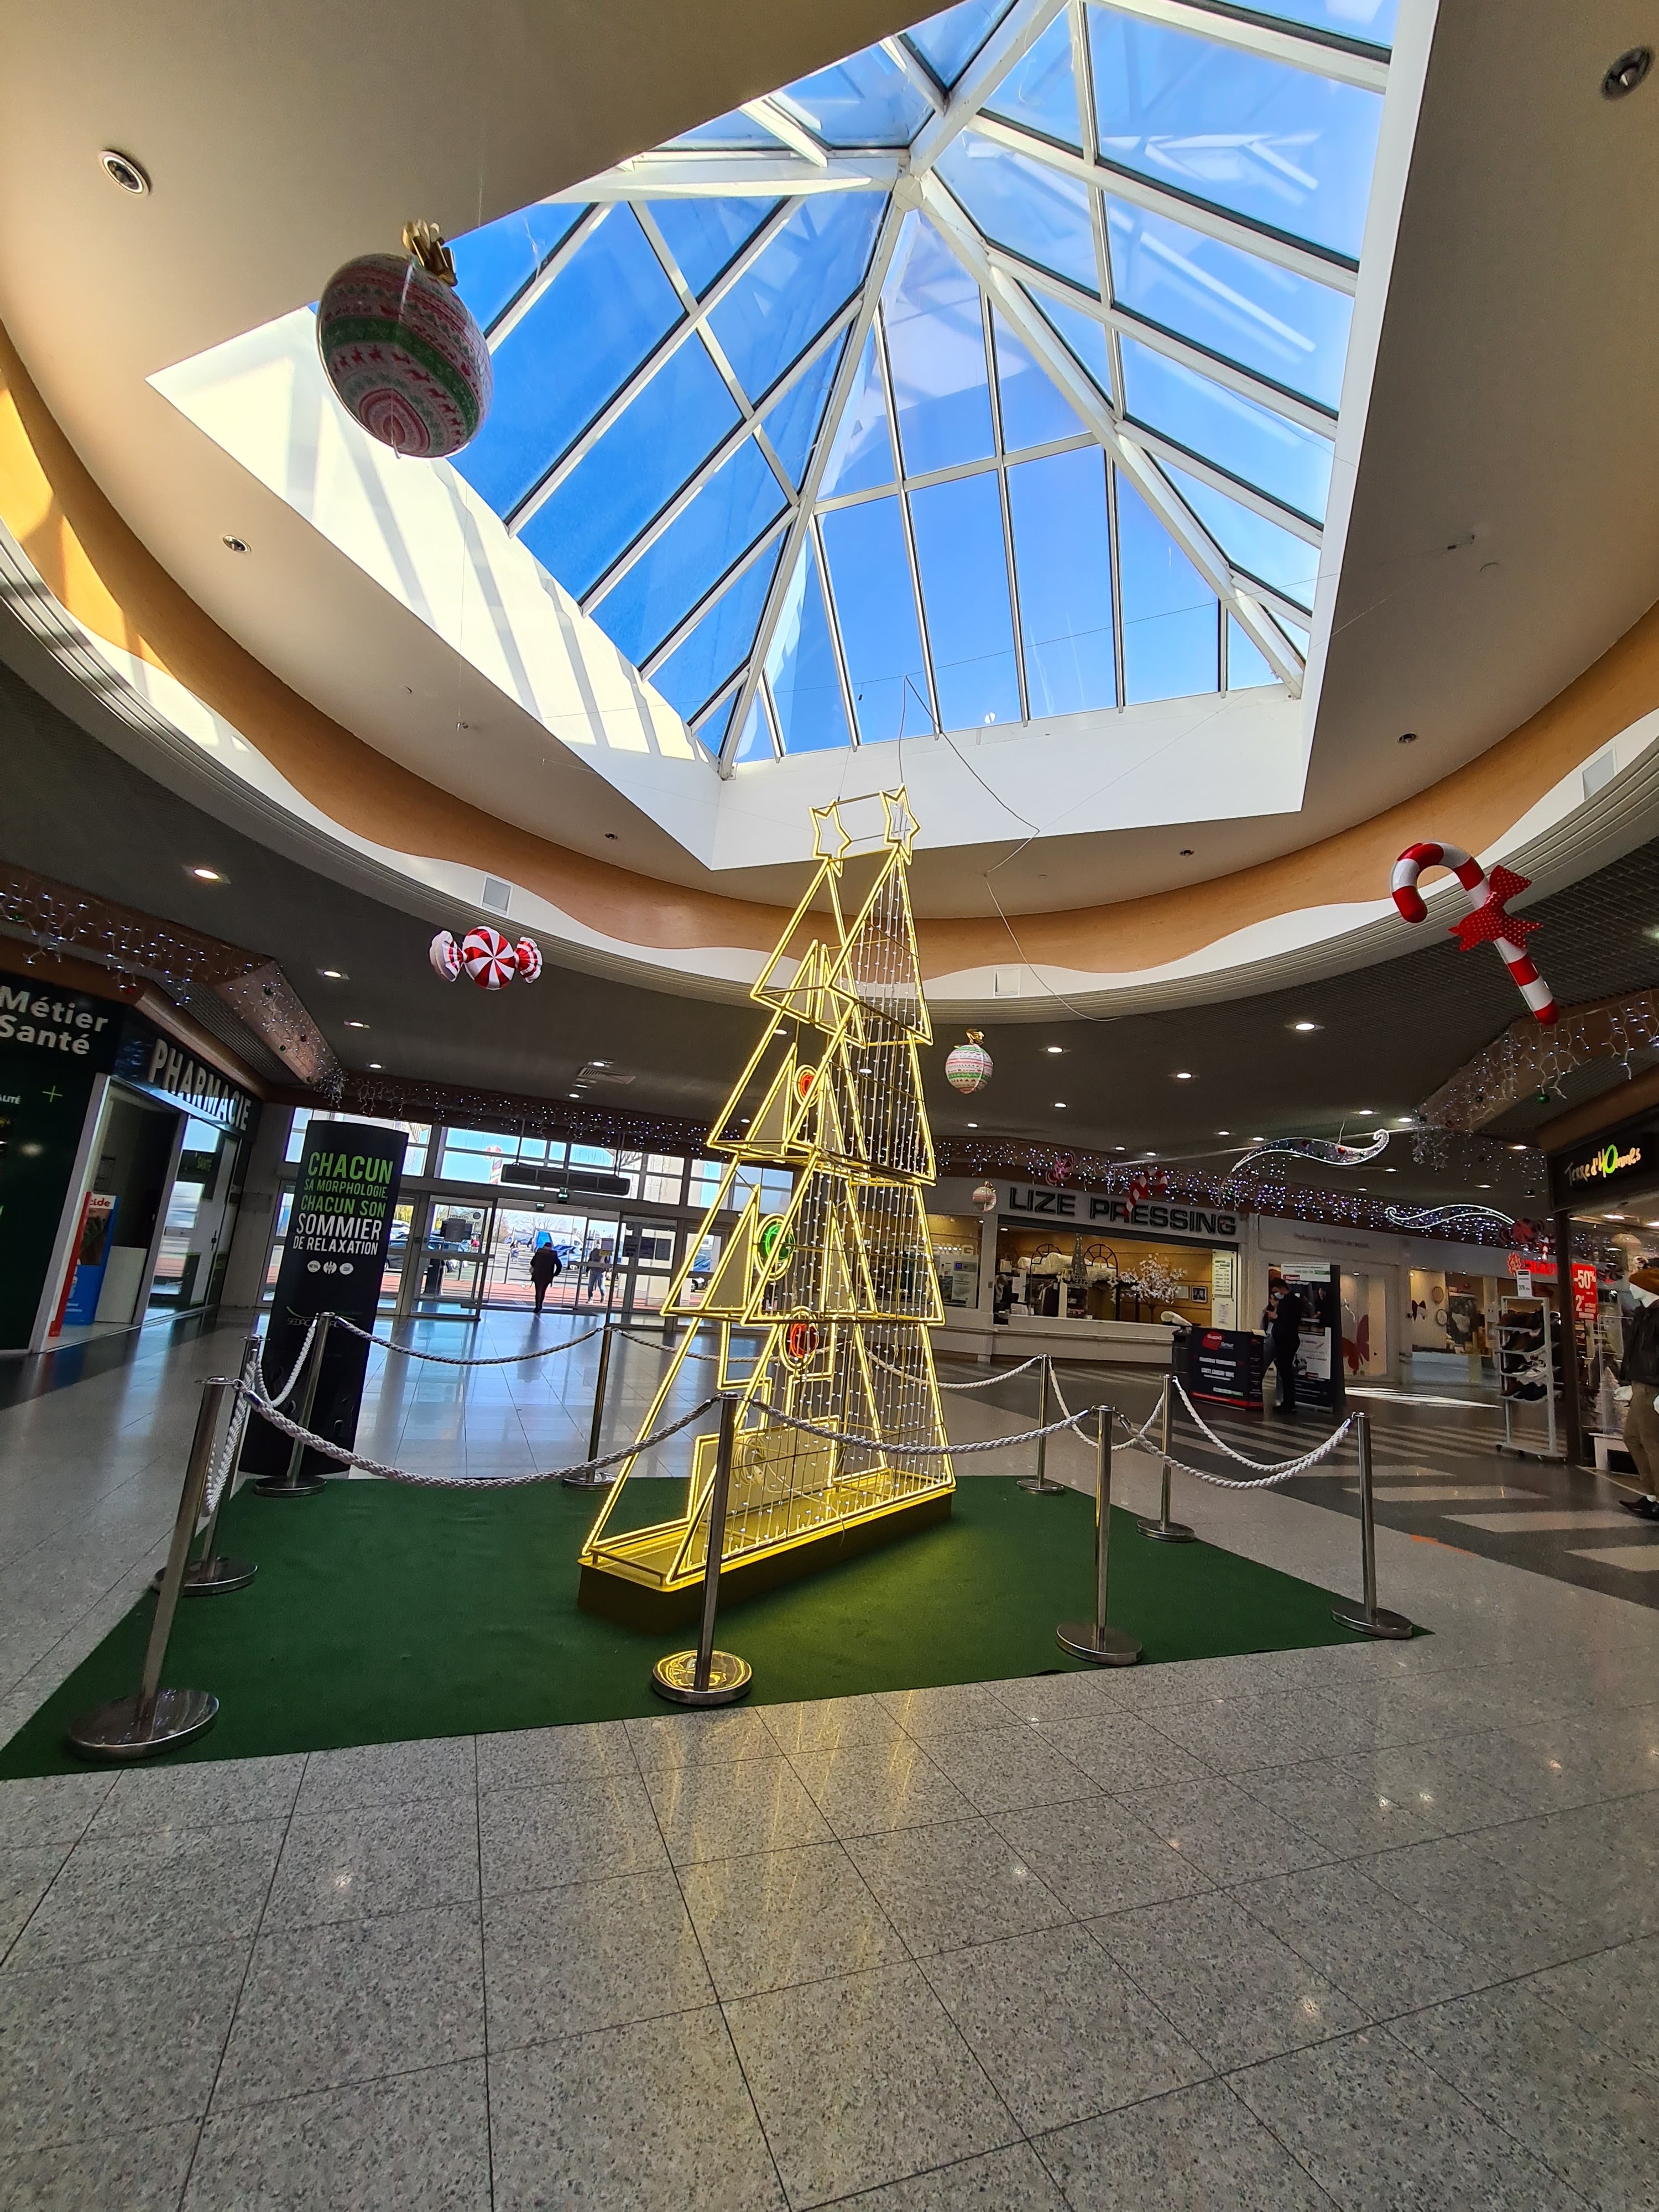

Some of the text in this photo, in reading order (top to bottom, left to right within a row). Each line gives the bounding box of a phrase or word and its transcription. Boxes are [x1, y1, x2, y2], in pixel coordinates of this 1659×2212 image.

[0, 985, 108, 1032] Métier
[0, 1014, 90, 1055] Santé
[148, 1037, 251, 1131] PHARMACIE
[307, 1151, 393, 1185] CHACUN
[304, 1178, 388, 1199] SA MORPHOLOGIE,
[300, 1194, 387, 1218] CHACUN SON
[1009, 1187, 1237, 1235] LIZE PRESSING
[296, 1212, 383, 1241] SOMMIER
[293, 1235, 379, 1256] DE RELAXATION
[1574, 1269, 1596, 1290] -50%
